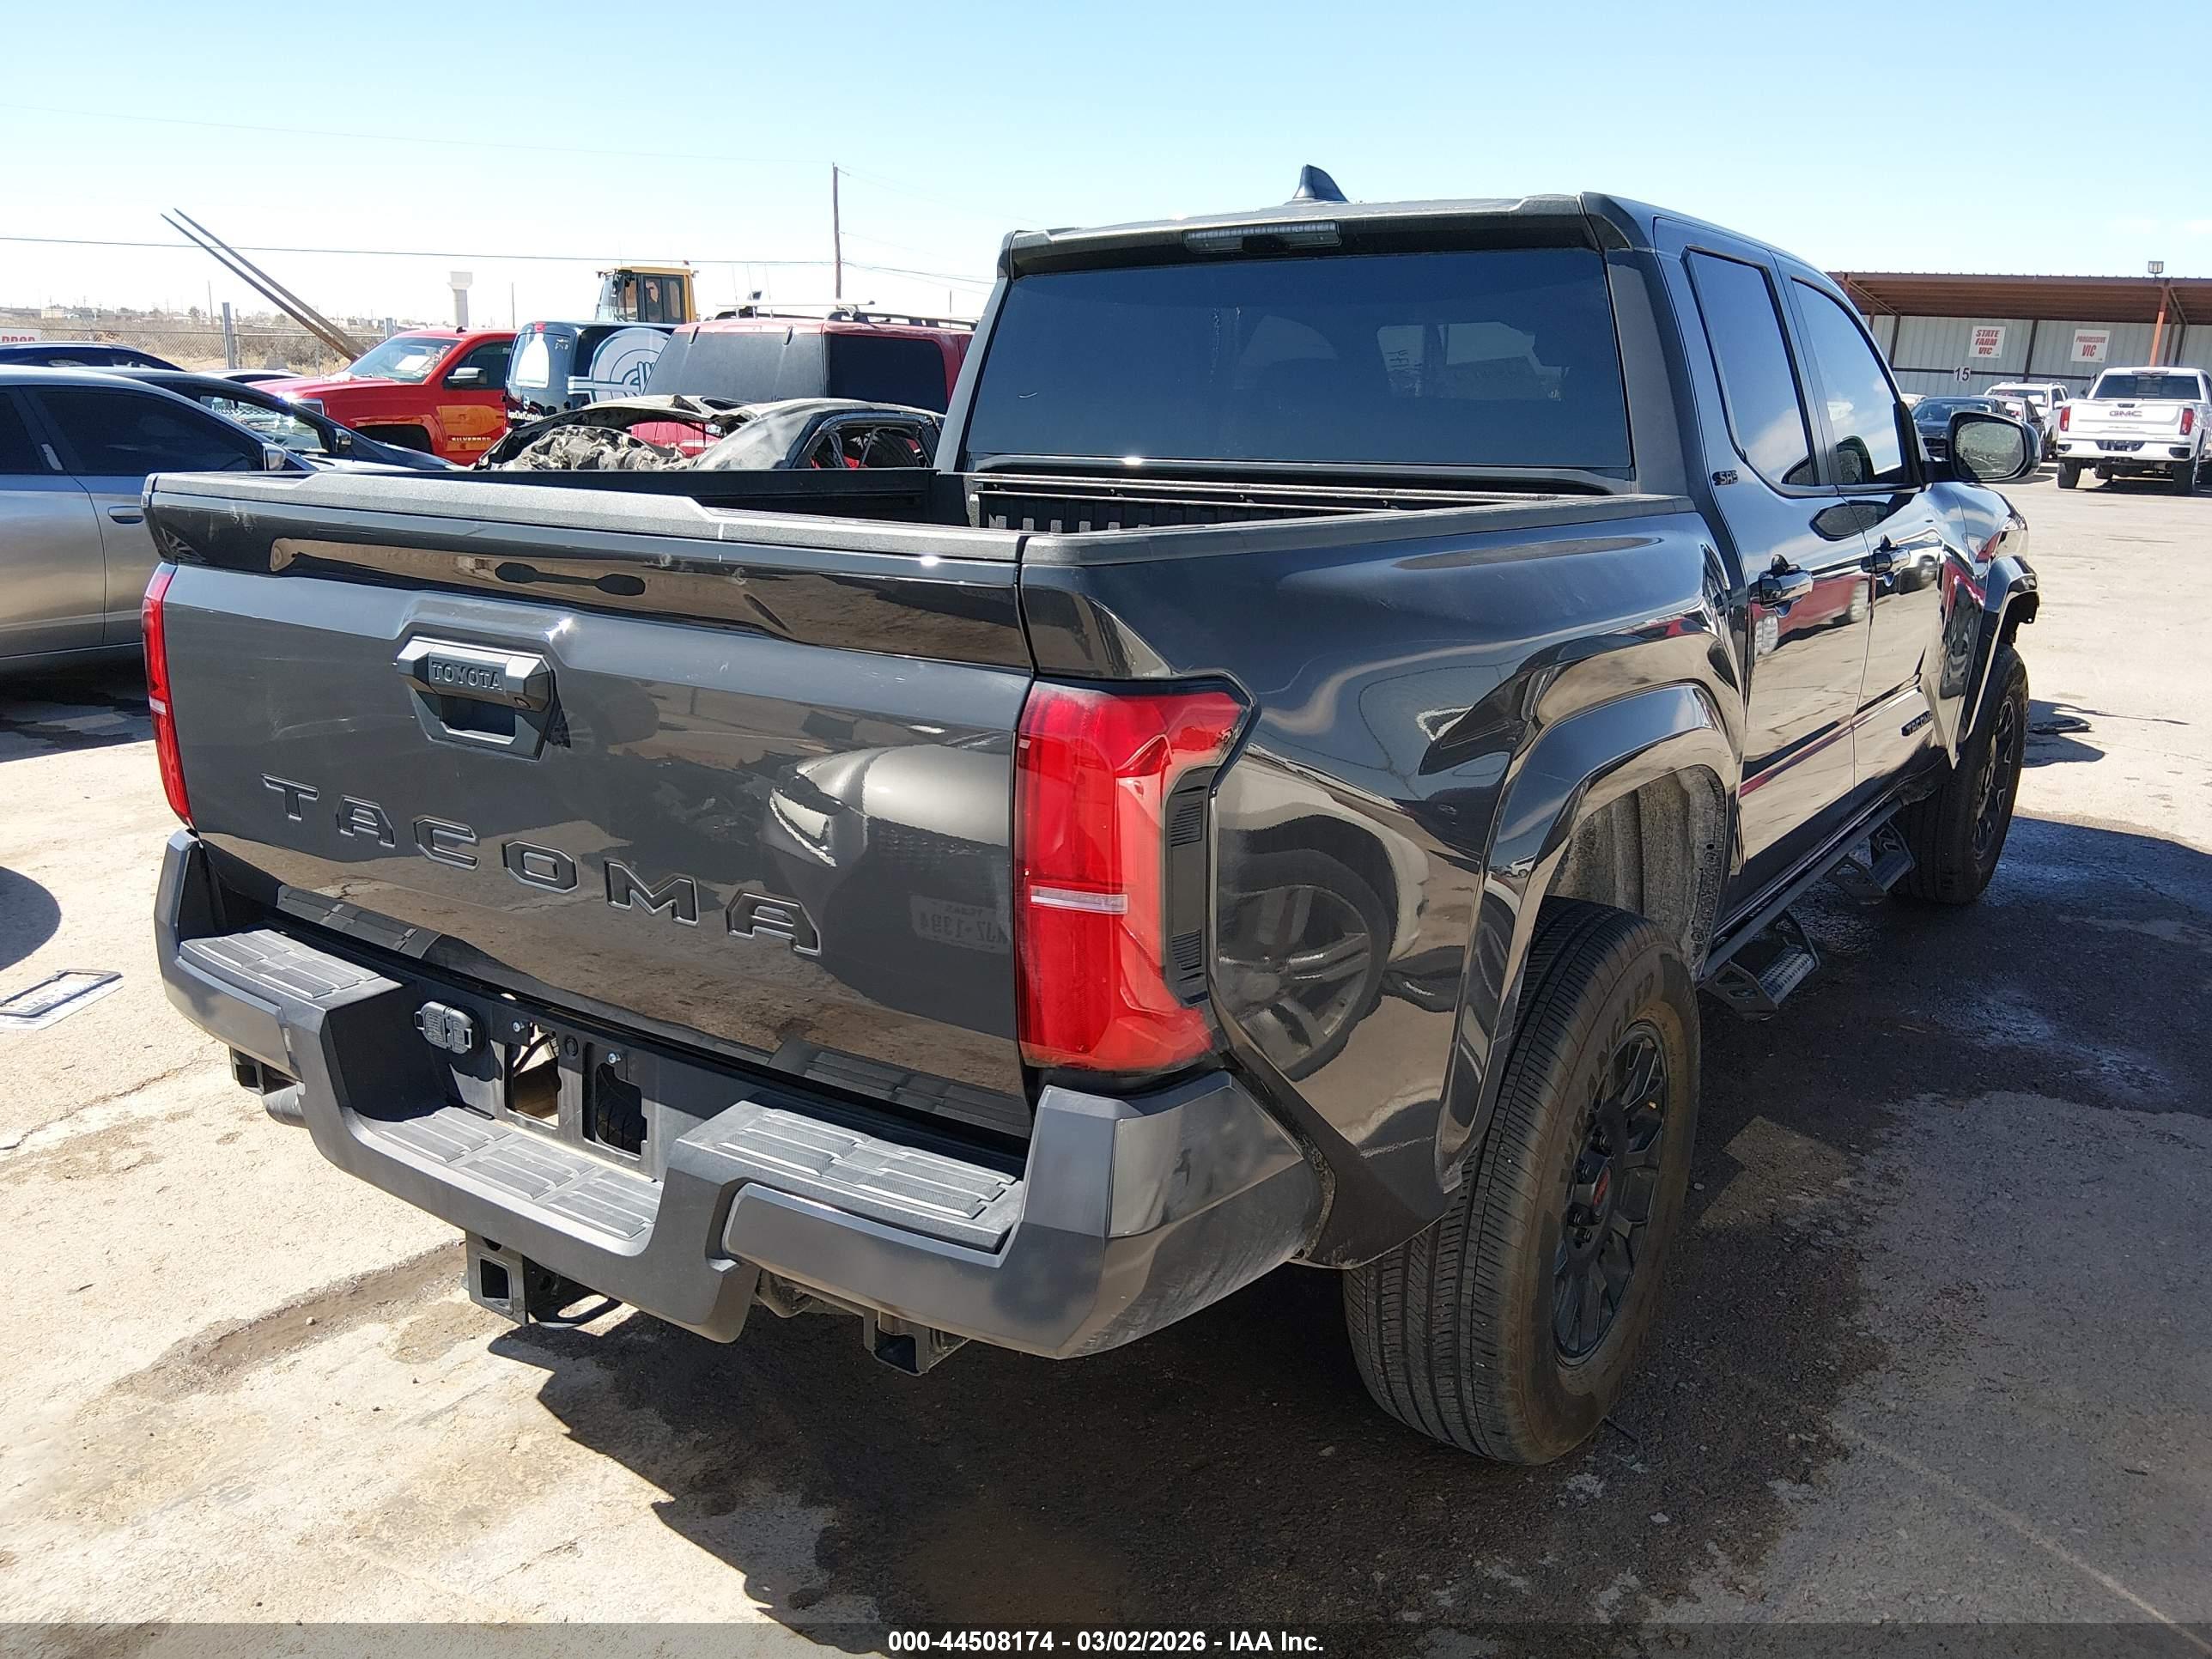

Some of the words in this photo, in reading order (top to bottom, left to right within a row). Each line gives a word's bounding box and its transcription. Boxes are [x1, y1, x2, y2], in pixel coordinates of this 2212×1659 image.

[2081, 344, 2097, 357] VIC
[1954, 367, 1970, 381] 15
[431, 661, 503, 691] TOYOTA
[262, 772, 823, 957] TACOMA
